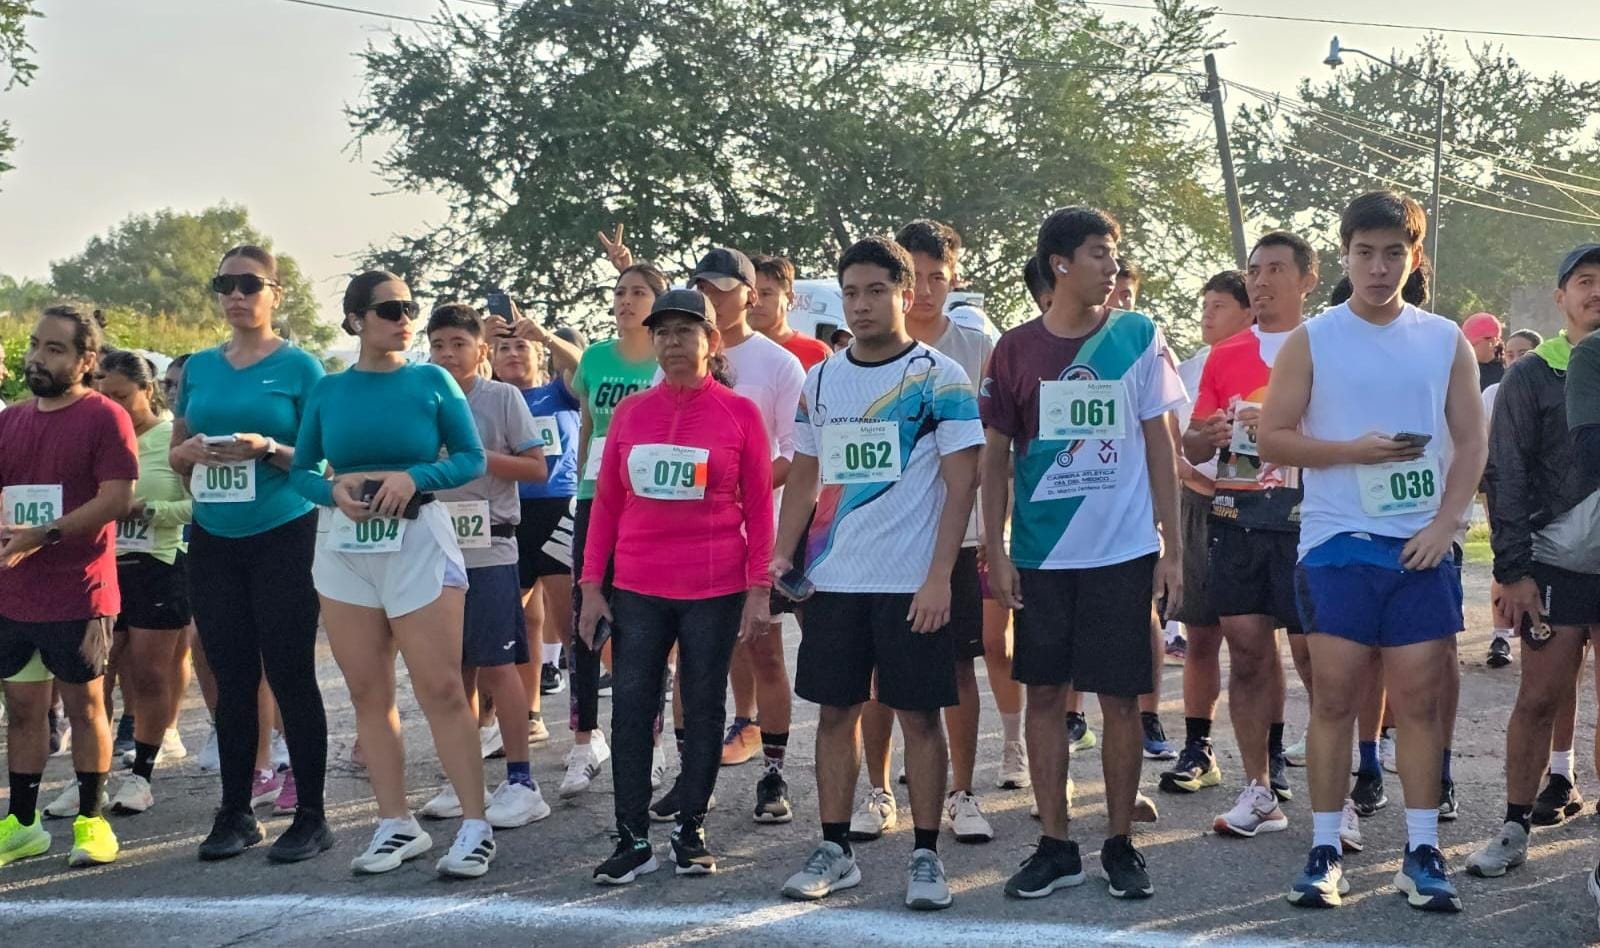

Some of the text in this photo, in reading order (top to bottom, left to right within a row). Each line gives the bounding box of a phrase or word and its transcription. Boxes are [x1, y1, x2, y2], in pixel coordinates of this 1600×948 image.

[1070, 399, 1115, 426] 061
[845, 440, 893, 471] 062
[1098, 452, 1117, 464] VI
[206, 465, 248, 490] 005
[654, 460, 696, 488] 079
[1390, 468, 1435, 501] 038
[14, 501, 54, 525] 043
[355, 516, 400, 543] 004
